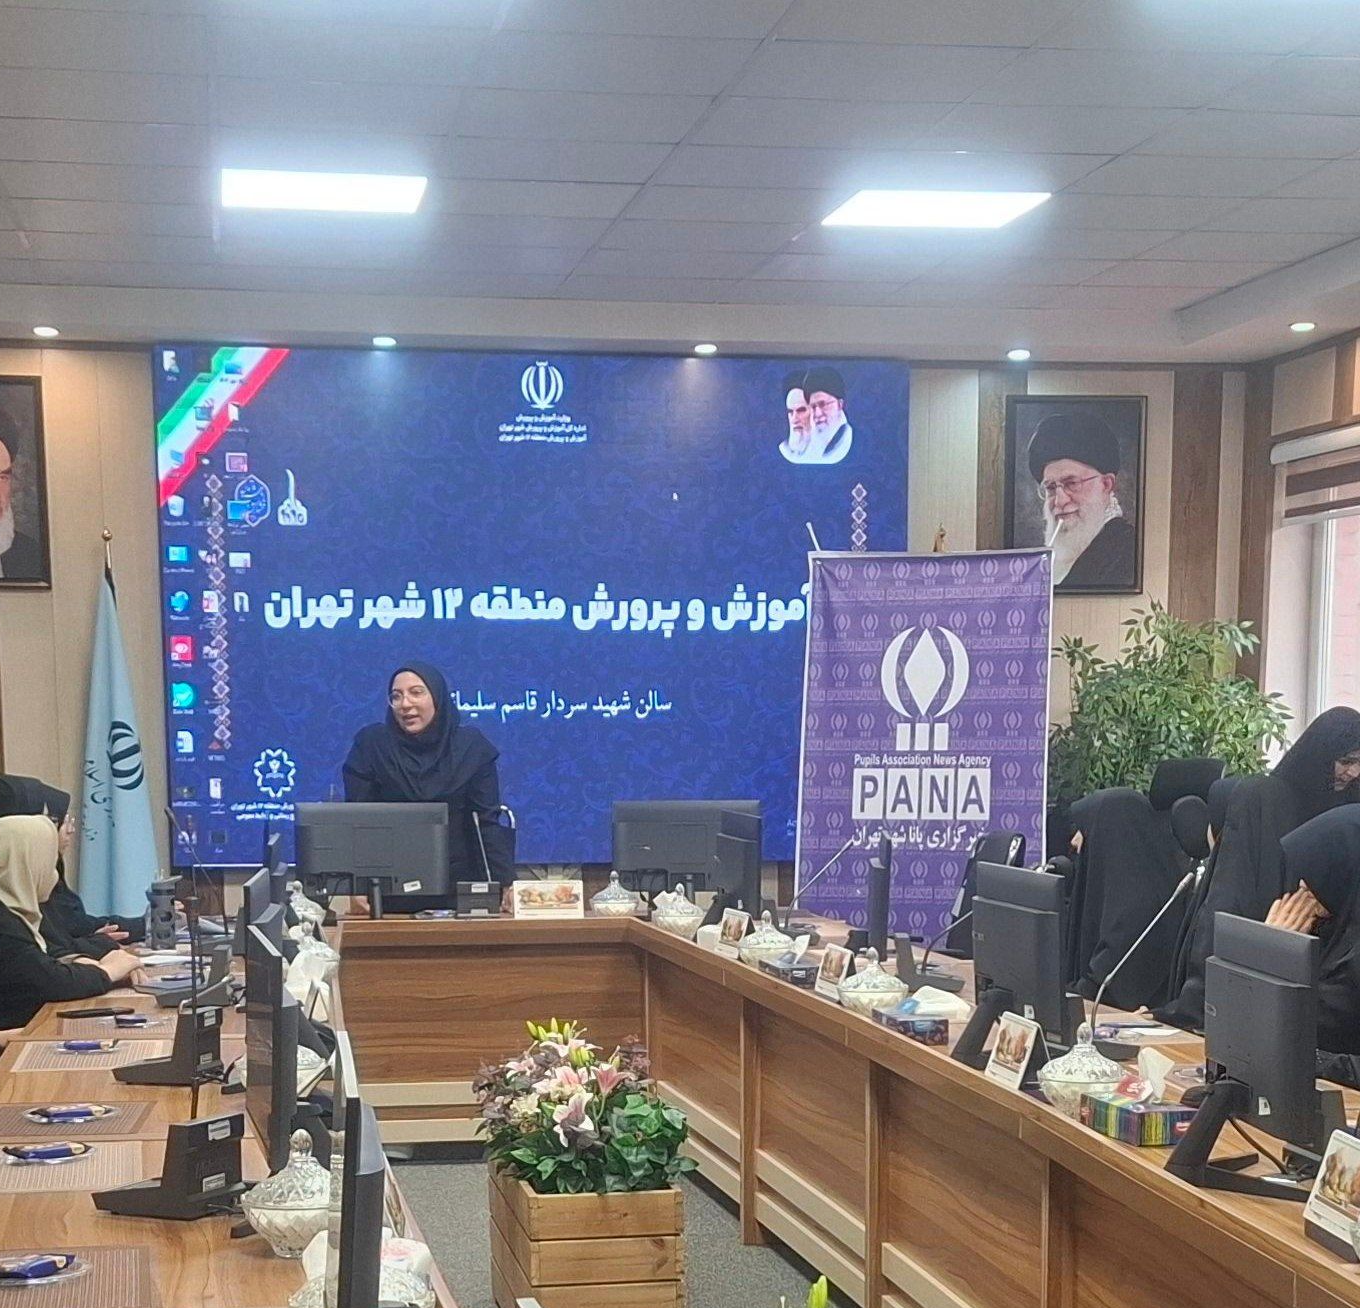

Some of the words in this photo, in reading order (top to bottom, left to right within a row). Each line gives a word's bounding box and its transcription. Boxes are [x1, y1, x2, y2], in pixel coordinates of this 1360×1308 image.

[264, 585, 354, 629] تهران
[359, 581, 426, 629] شهر
[470, 586, 566, 620] منطقه
[572, 582, 681, 638] پرورش
[687, 598, 705, 631] و
[449, 689, 497, 718] سلیمان
[500, 690, 538, 723] قاسم
[541, 689, 588, 719] سردار
[592, 690, 631, 718] شهید
[635, 689, 673, 719] سالن
[854, 753, 880, 767] Pupils
[881, 753, 931, 766] Association
[933, 753, 957, 766] News
[958, 753, 992, 768] Agency
[859, 774, 986, 814] PANA
[852, 825, 883, 850] تهران
[890, 825, 907, 848] شه
[908, 826, 924, 850] پانا
